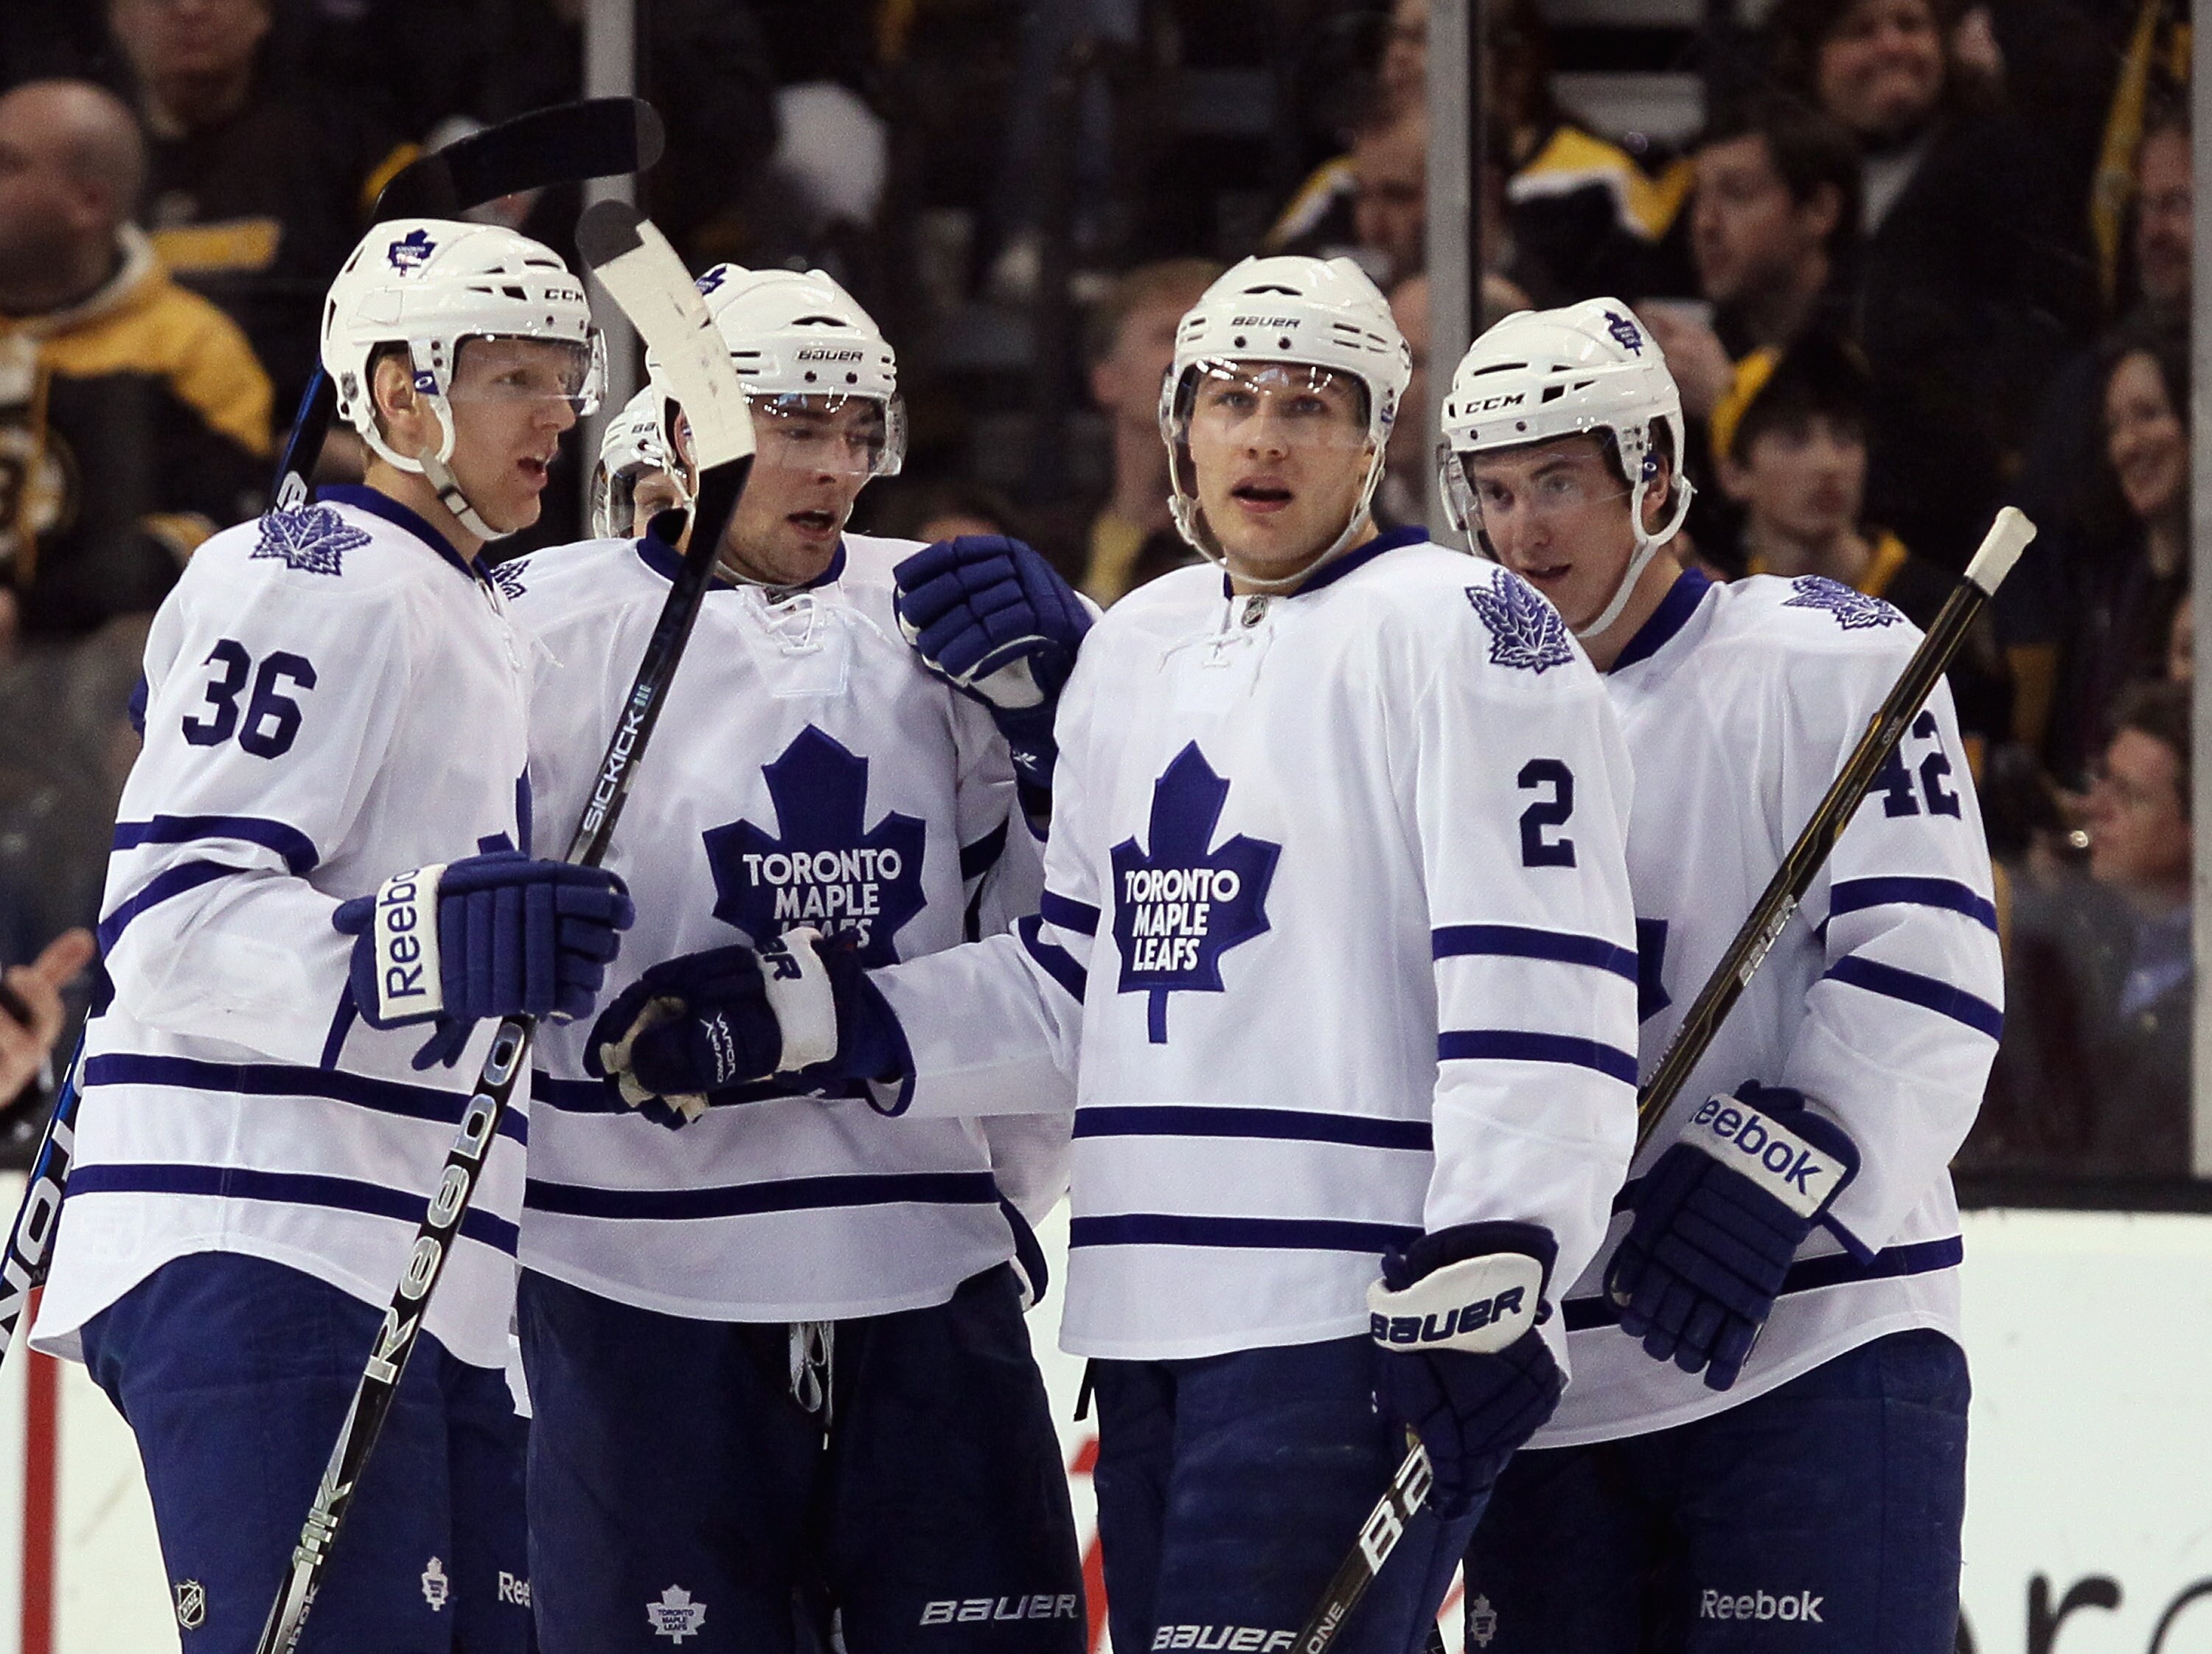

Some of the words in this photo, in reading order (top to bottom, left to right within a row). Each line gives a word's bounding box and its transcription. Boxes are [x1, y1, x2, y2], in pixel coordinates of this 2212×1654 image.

[1464, 392, 1526, 414] CCM
[182, 639, 317, 759] 36
[582, 709, 644, 833] SICKICK
[1868, 709, 1963, 821] 42
[1517, 758, 1578, 868] 2
[742, 848, 902, 886] TORONTO
[1124, 868, 1241, 903] TORONTO
[379, 869, 427, 998] Reebo
[774, 883, 880, 920] MAPLE
[1132, 902, 1211, 937] MAPLE
[1132, 937, 1201, 972] LEAFS
[1694, 1099, 1823, 1196] eebok
[364, 1021, 526, 1384] Reebo
[1700, 1588, 1824, 1623] Reebok
